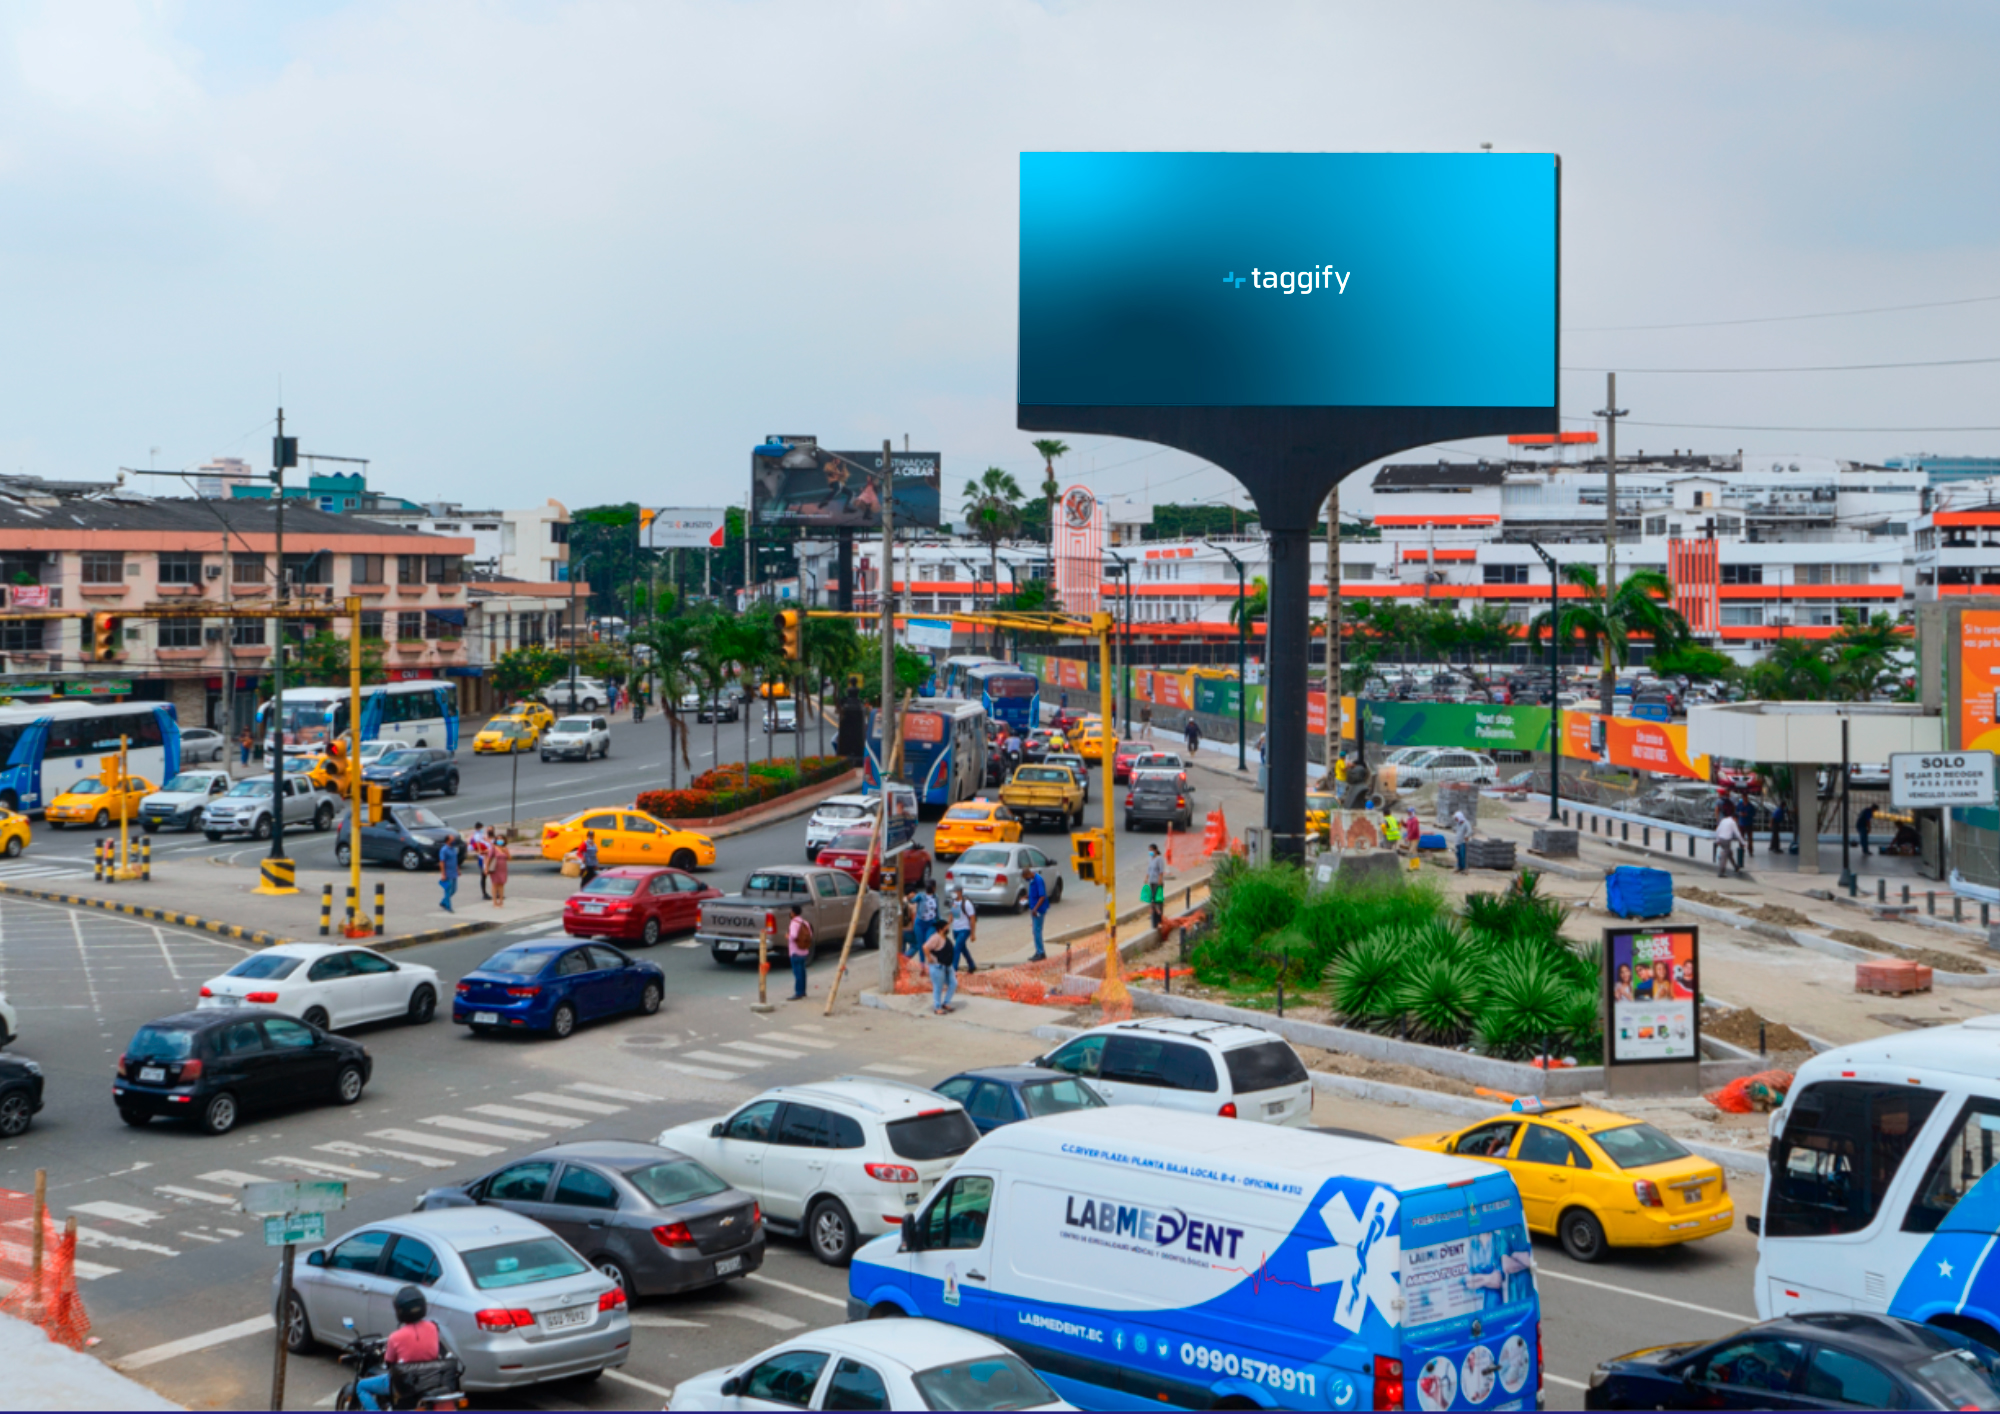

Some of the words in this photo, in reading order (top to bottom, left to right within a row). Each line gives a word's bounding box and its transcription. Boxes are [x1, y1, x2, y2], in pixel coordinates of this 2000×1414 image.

[1251, 265, 1351, 294] taggify
[875, 458, 934, 468] DSTINADOS
[1921, 757, 1965, 769] SOLO
[1943, 771, 1984, 779] RECOGER
[1948, 790, 1978, 798] LIVIANOS
[711, 915, 756, 927] TOYOTA
[1636, 937, 1669, 949] BACK
[1638, 946, 1672, 959] COOL
[1131, 1156, 1164, 1170] PLANTA
[1166, 1162, 1188, 1175] BAJA
[1190, 1167, 1217, 1180] LOCAL
[1243, 1177, 1279, 1191] OFICINA
[1066, 1196, 1244, 1260] LABMEDENT
[1019, 1311, 1103, 1343] LABMEDENT.EC
[1180, 1342, 1317, 1397] 0990578911
